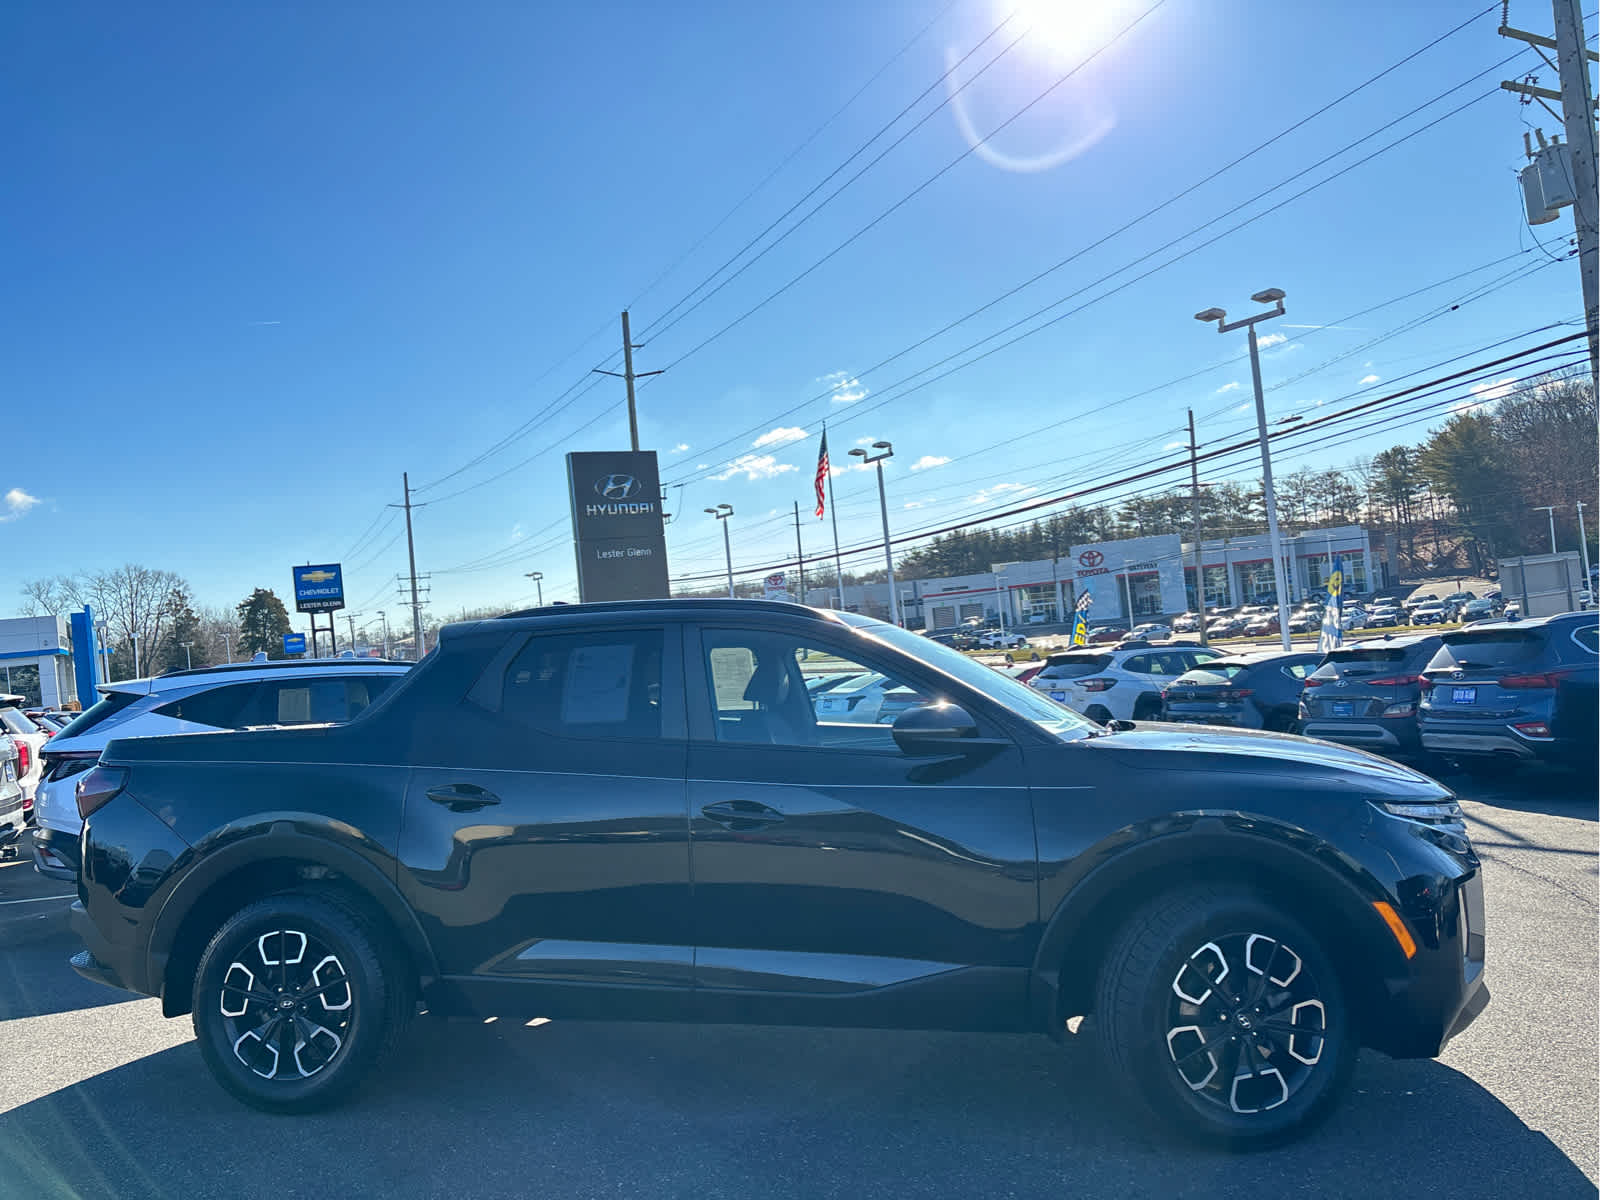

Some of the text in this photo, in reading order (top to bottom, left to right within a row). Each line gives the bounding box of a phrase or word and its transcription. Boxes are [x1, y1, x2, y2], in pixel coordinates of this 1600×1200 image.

[586, 502, 654, 516] HYUNDAI
[597, 547, 651, 559] Lester Glenn
[1077, 567, 1109, 577] TOYOTA
[299, 587, 339, 596] CHEVROLET
